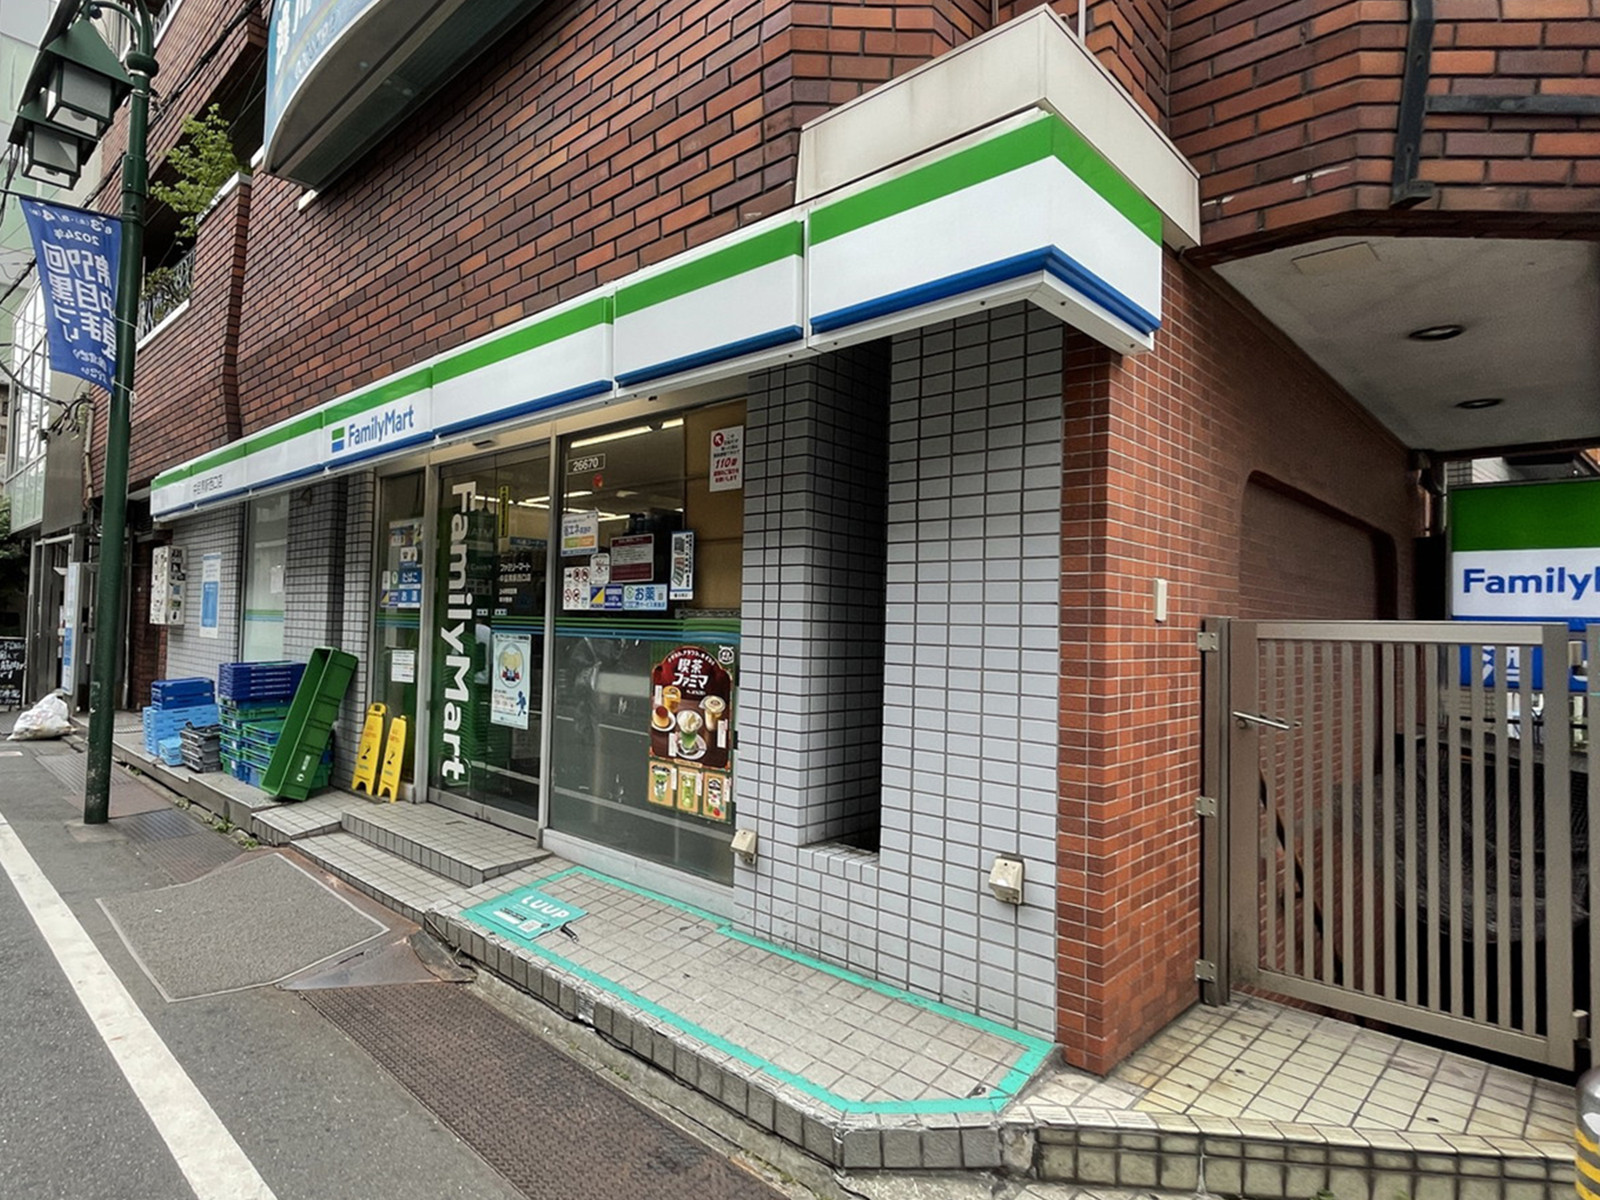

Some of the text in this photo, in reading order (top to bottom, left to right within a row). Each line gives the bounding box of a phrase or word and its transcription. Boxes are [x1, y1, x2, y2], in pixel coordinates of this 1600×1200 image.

[348, 404, 415, 447] FamilyMart
[572, 457, 599, 471] 26670
[634, 586, 655, 601] お薬
[1463, 566, 1600, 601] Family
[440, 481, 477, 780] FamilyMart
[677, 658, 704, 675] 喫茶
[672, 672, 709, 689] ファミマ
[521, 895, 571, 919] LUUP
